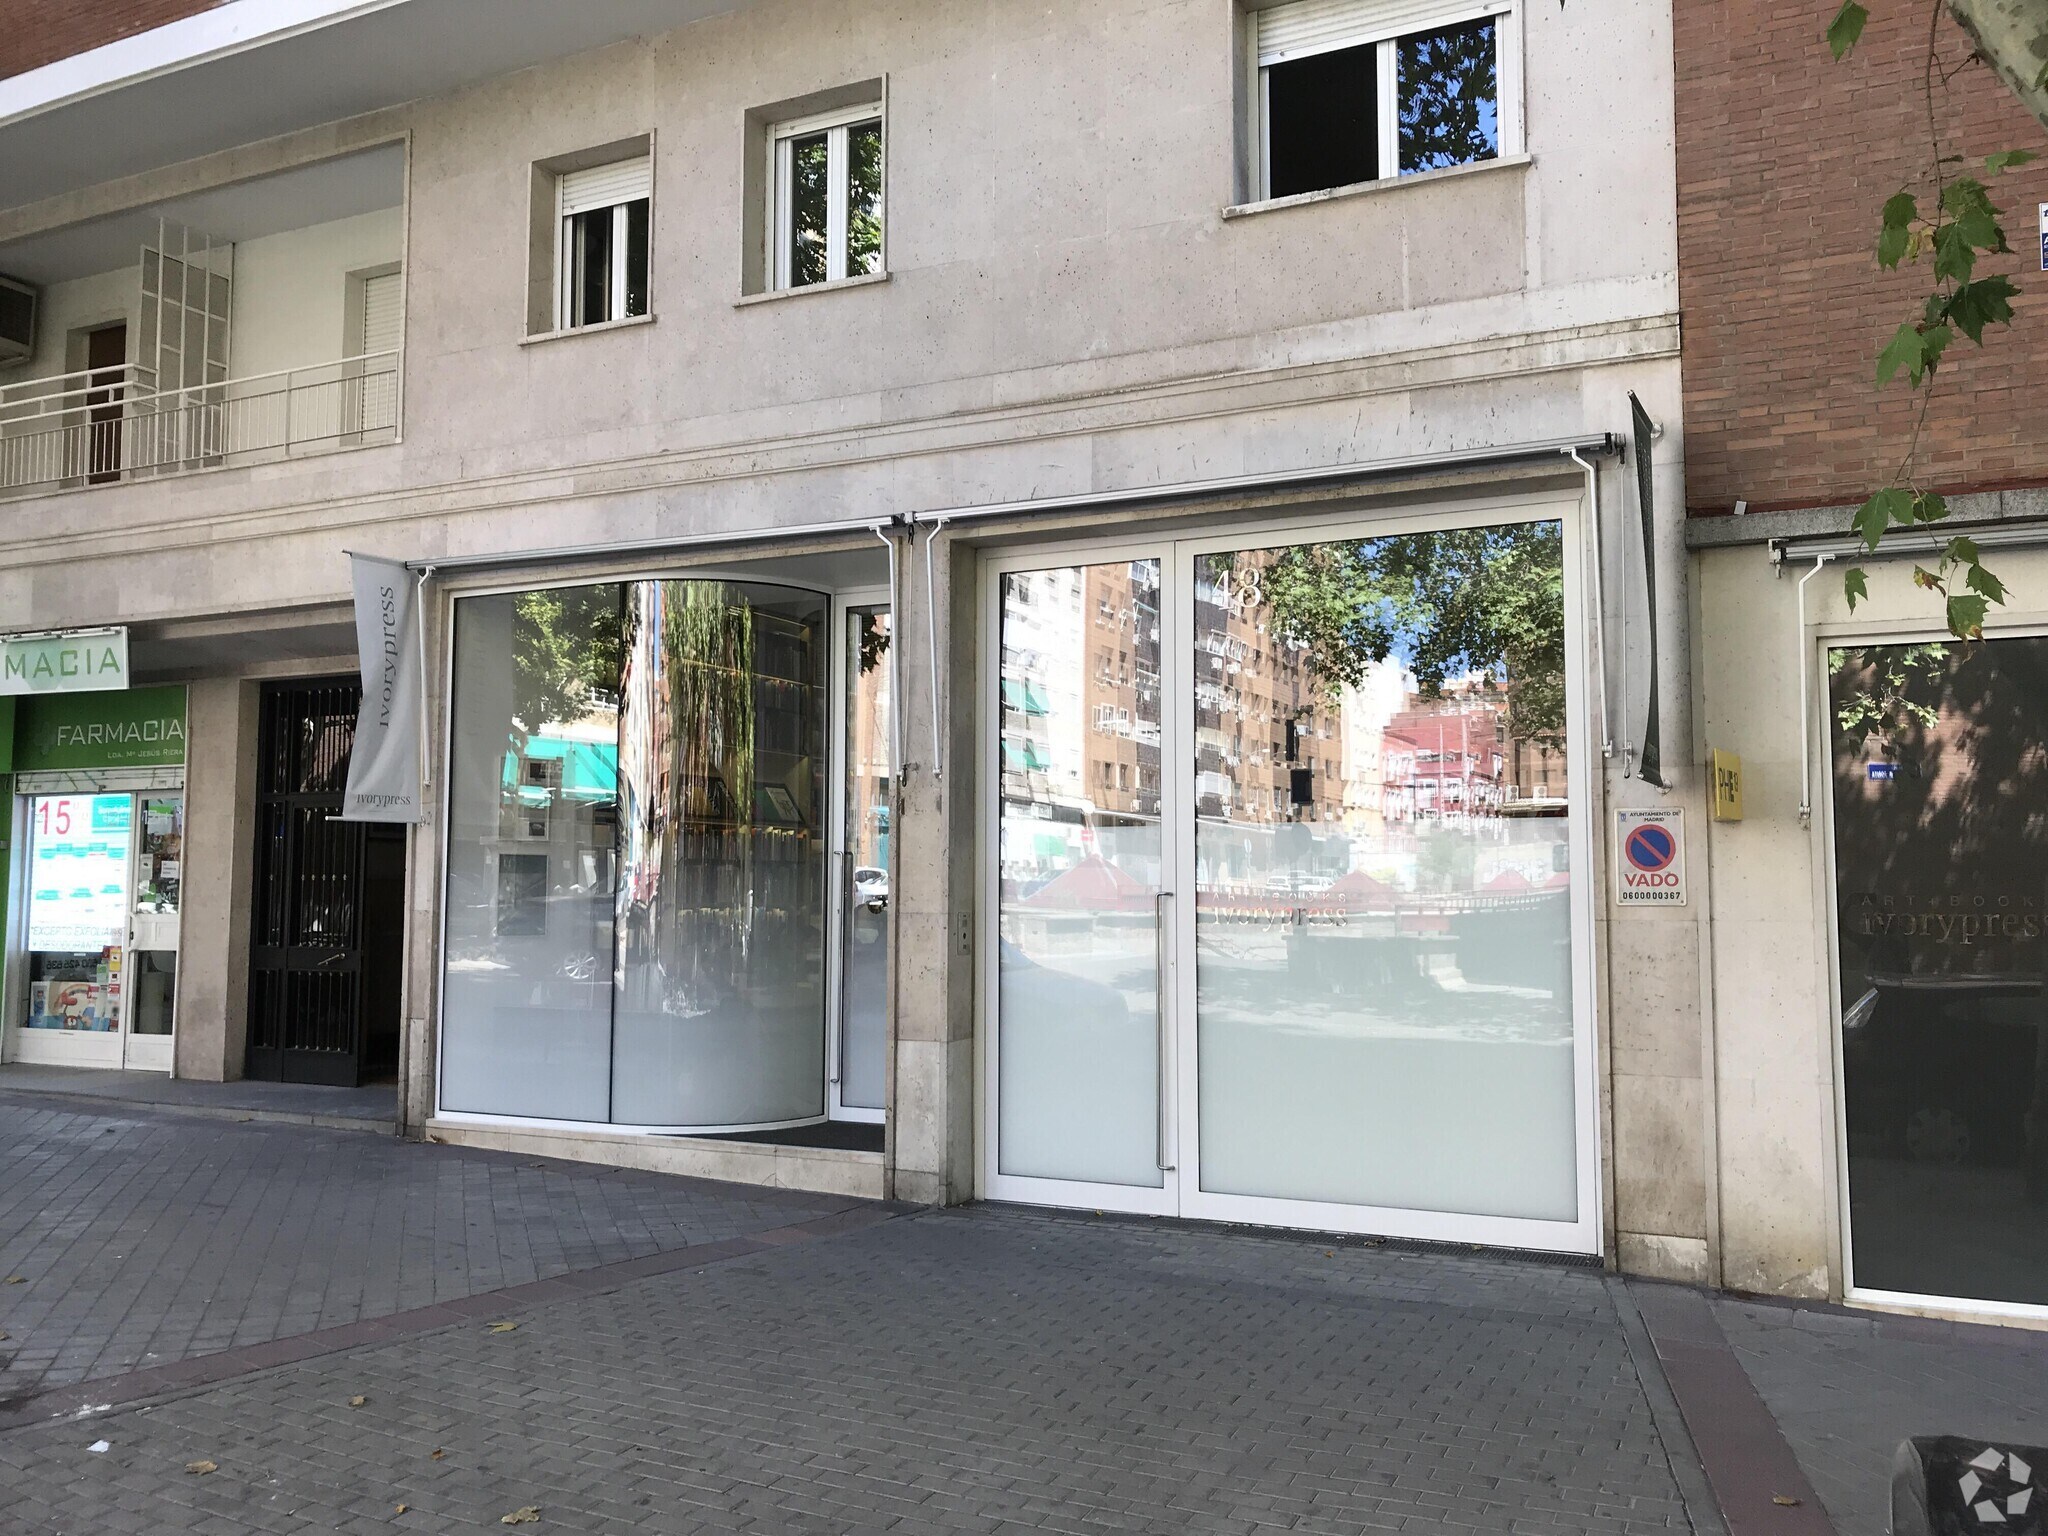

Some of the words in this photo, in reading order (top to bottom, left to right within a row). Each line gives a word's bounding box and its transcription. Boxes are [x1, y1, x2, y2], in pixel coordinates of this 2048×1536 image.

[1211, 567, 1261, 611] 48
[5, 647, 121, 680] MACIA
[379, 586, 399, 728] ivorypress
[57, 719, 184, 747] FARMACIA
[356, 793, 411, 807] ivorypress
[39, 800, 71, 835] 15
[1622, 892, 1681, 900] 0600000367
[1624, 873, 1679, 887] VADO
[1861, 913, 2048, 945] ivorypres
